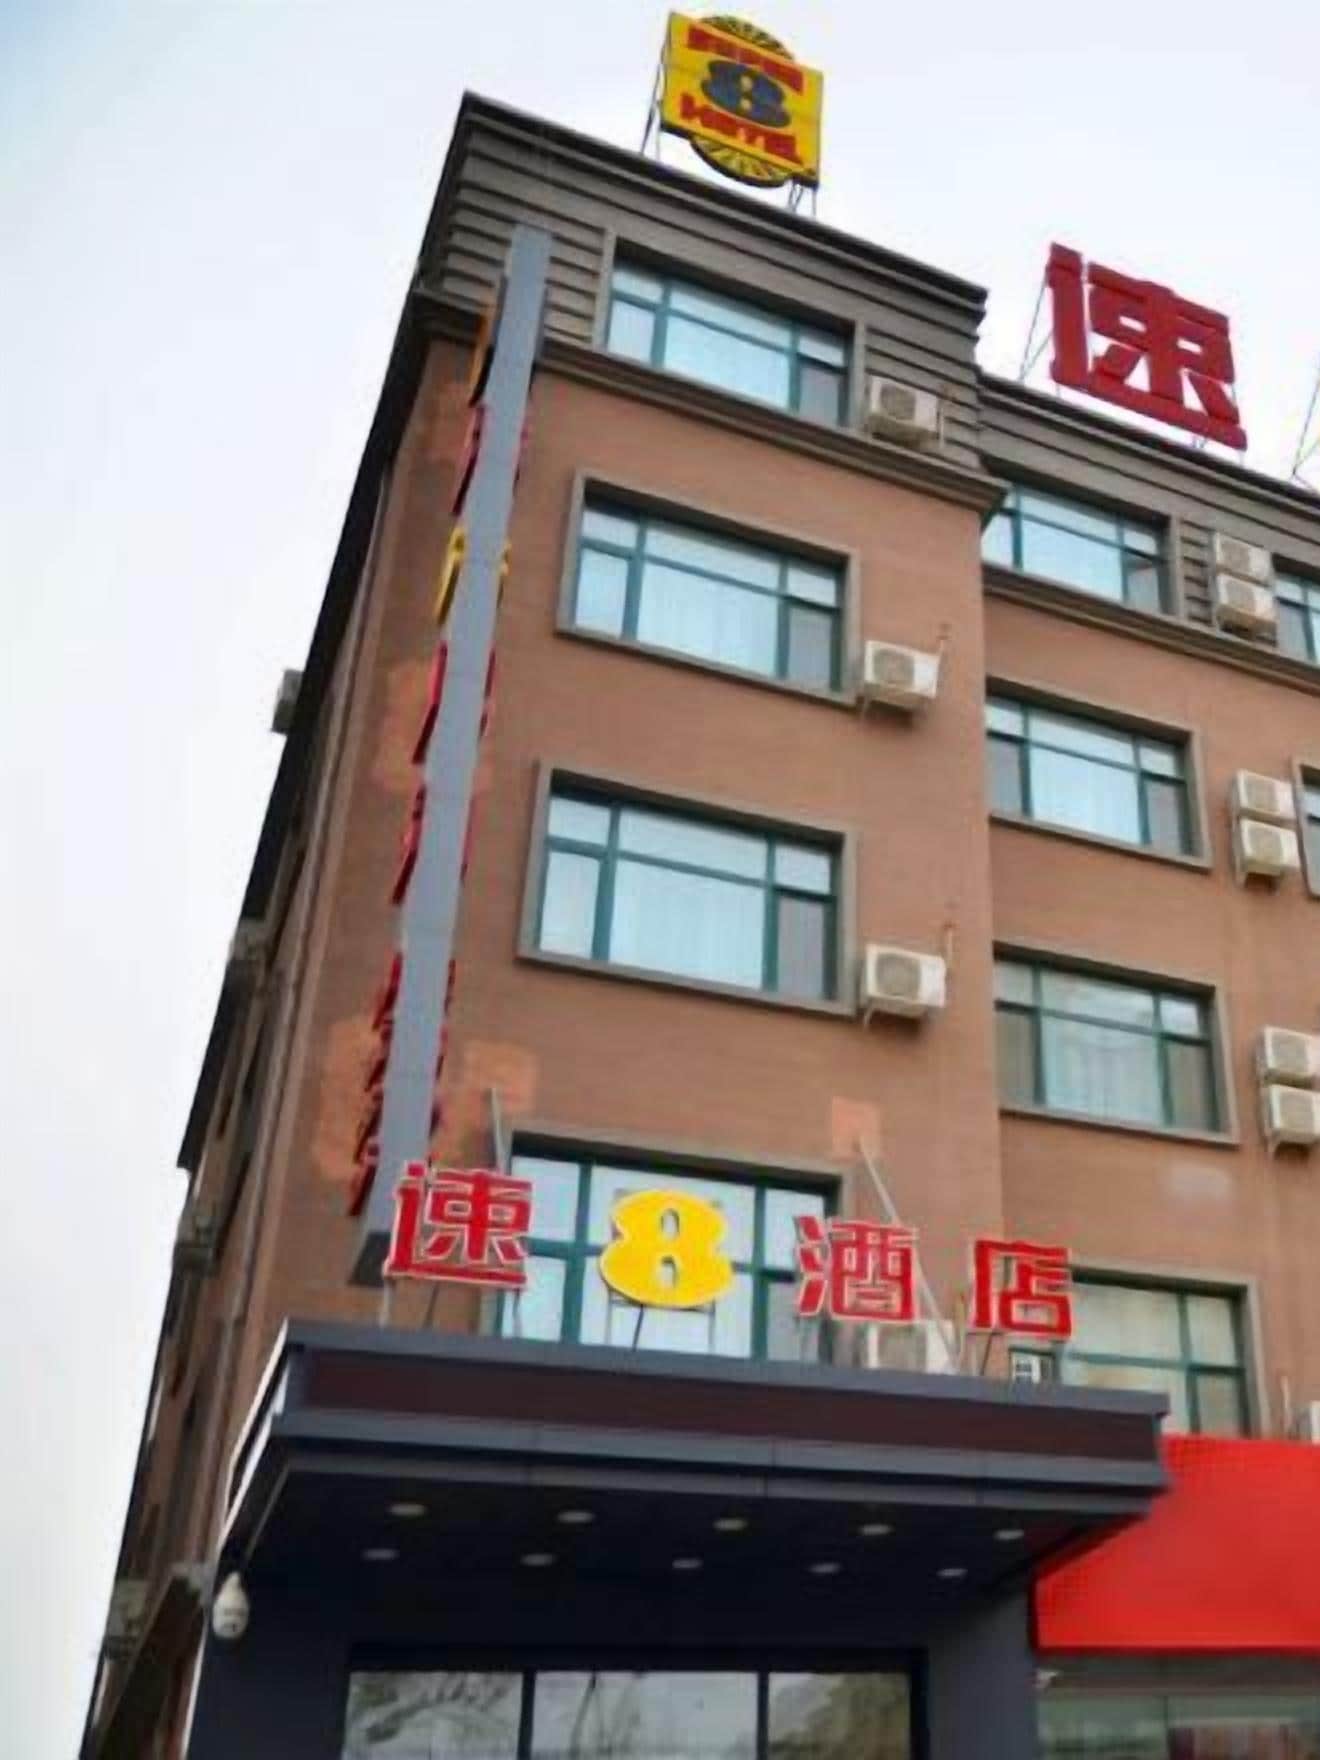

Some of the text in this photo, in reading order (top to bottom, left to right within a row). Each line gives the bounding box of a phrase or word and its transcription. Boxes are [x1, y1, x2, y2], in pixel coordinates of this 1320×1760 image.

[701, 60, 792, 128] 8
[383, 1163, 1073, 1341] 速8酒店
